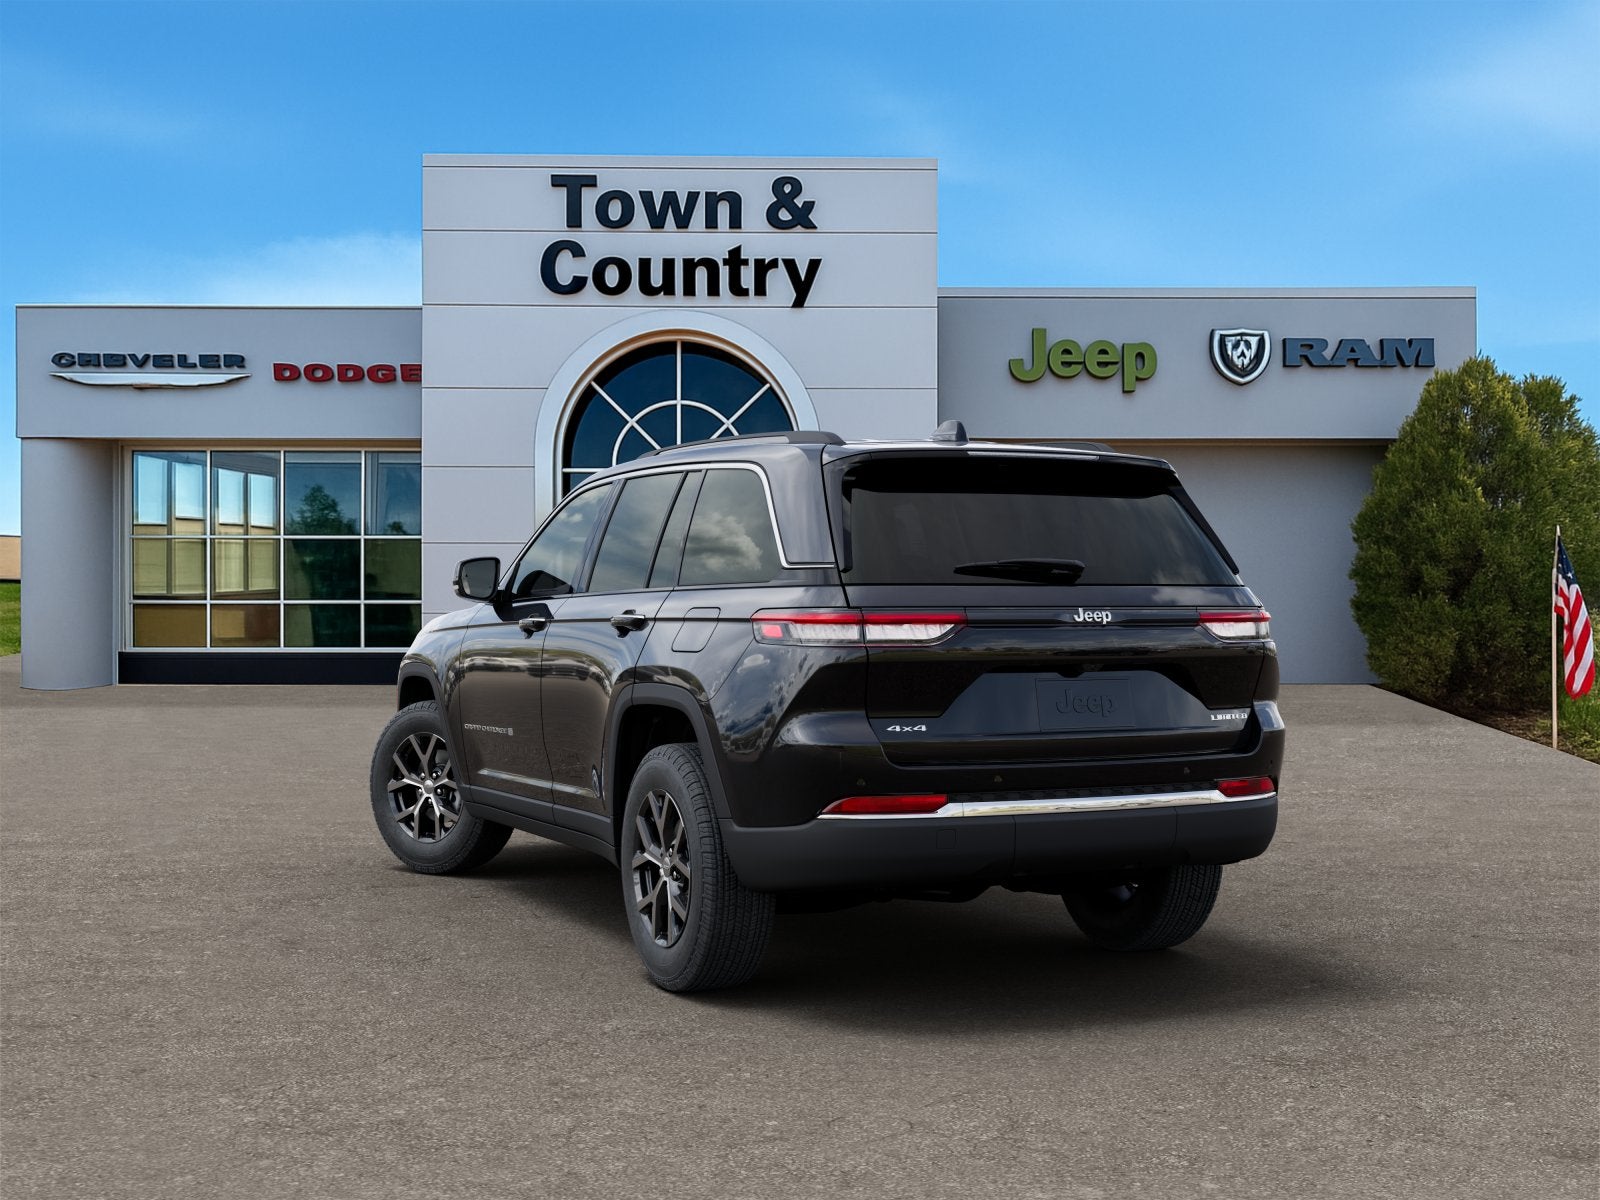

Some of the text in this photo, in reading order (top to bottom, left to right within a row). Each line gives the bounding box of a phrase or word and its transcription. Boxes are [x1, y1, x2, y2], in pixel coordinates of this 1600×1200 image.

[550, 174, 818, 230] Town &
[540, 239, 823, 308] Country
[1008, 327, 1158, 393] Jeep
[1282, 337, 1435, 367] RAM
[272, 363, 422, 383] DODGE
[1073, 607, 1112, 625] Jeep
[1055, 688, 1115, 718] Jeep
[886, 724, 928, 732] 4x4
